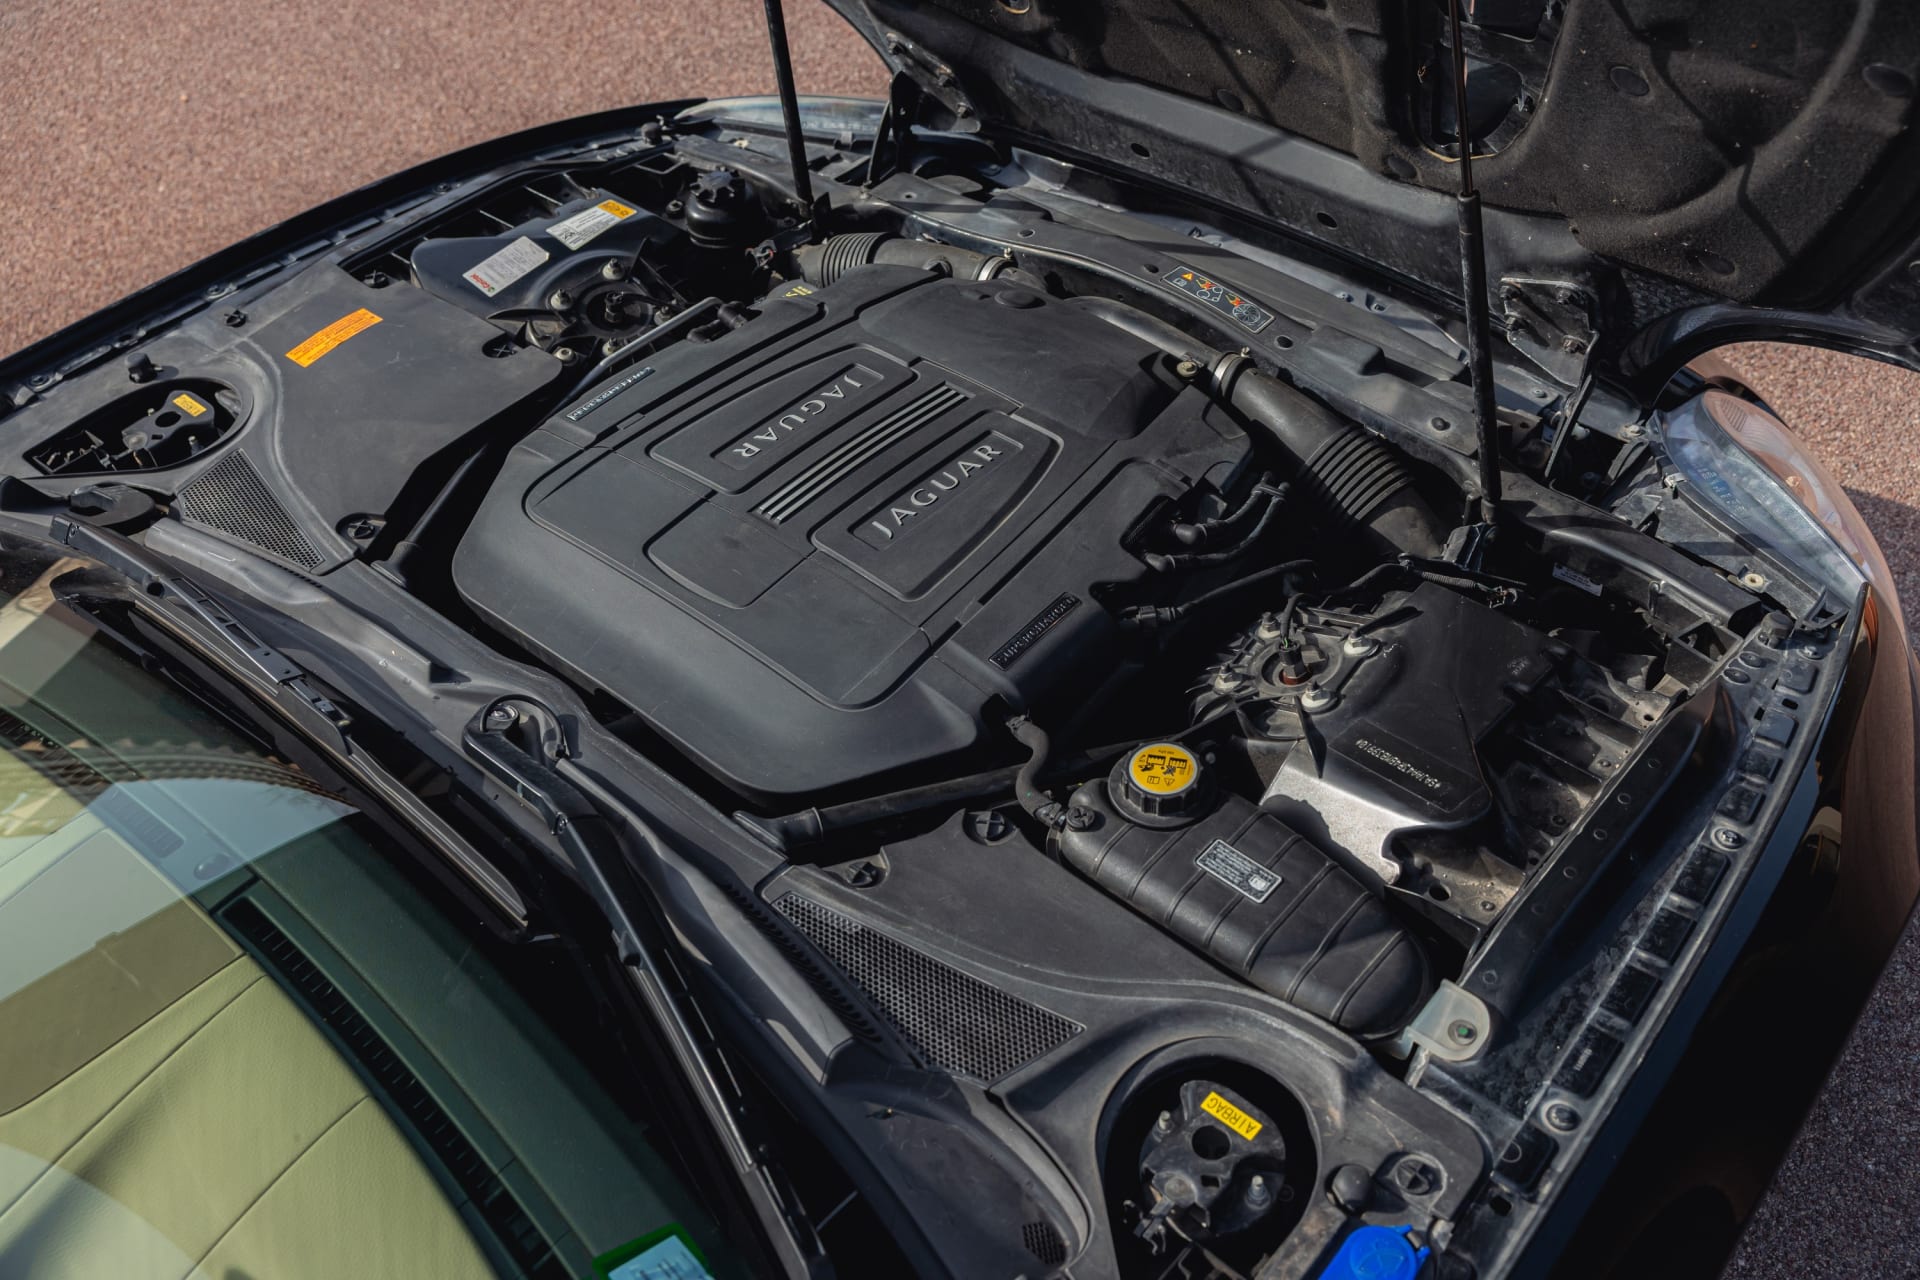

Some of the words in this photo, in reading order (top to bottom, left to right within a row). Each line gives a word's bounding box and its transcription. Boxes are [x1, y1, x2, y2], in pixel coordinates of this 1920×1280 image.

[732, 373, 863, 458] JAGUAR
[871, 444, 1003, 540] JAGUAR
[1206, 1097, 1257, 1135] AIRBAG
